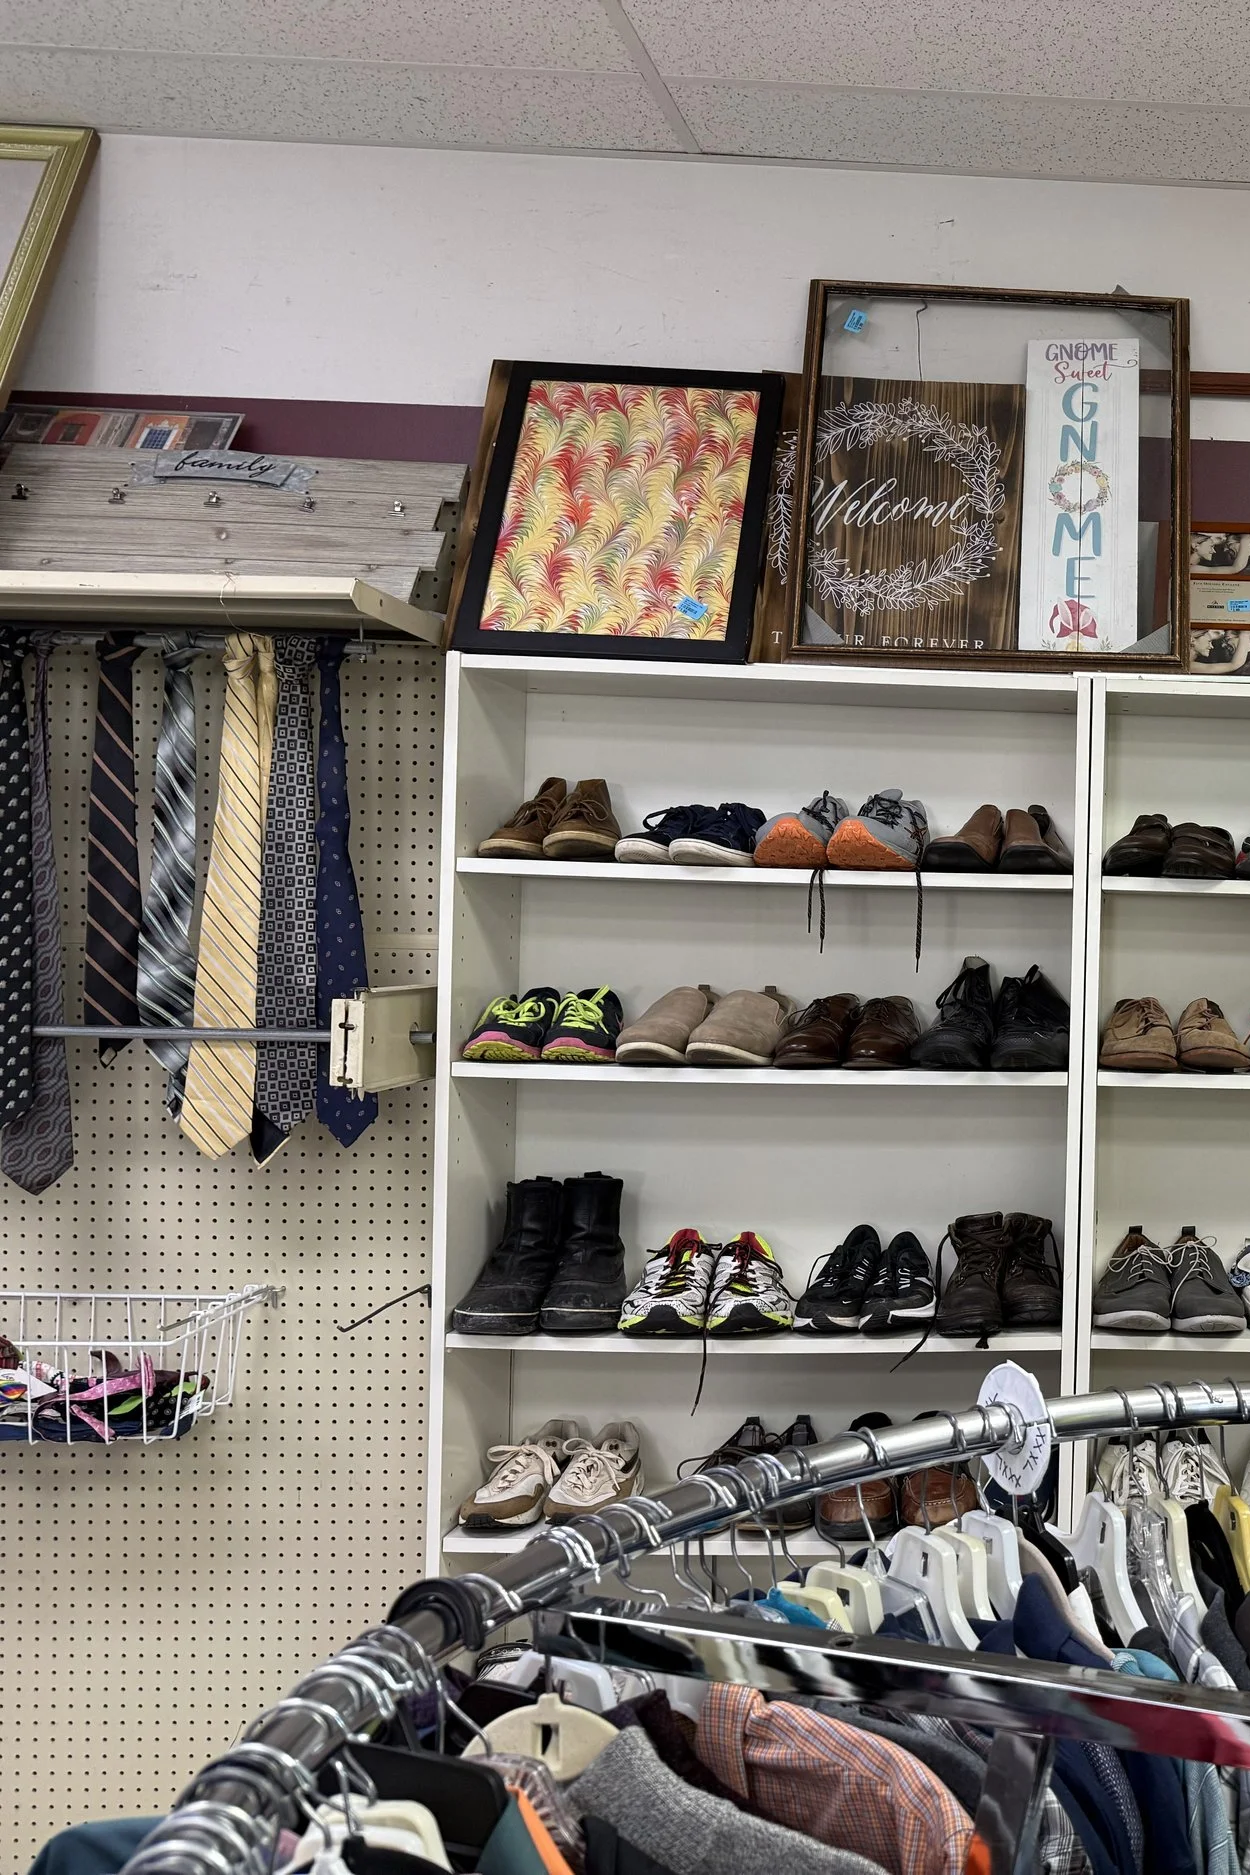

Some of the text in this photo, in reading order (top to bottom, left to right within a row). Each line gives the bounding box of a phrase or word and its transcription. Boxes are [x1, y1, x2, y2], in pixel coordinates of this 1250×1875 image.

[1045, 342, 1119, 361] GNOME
[1054, 360, 1138, 385] Sweet
[174, 451, 277, 478] family
[811, 475, 970, 536] Welcome
[881, 635, 984, 649] FOREVER
